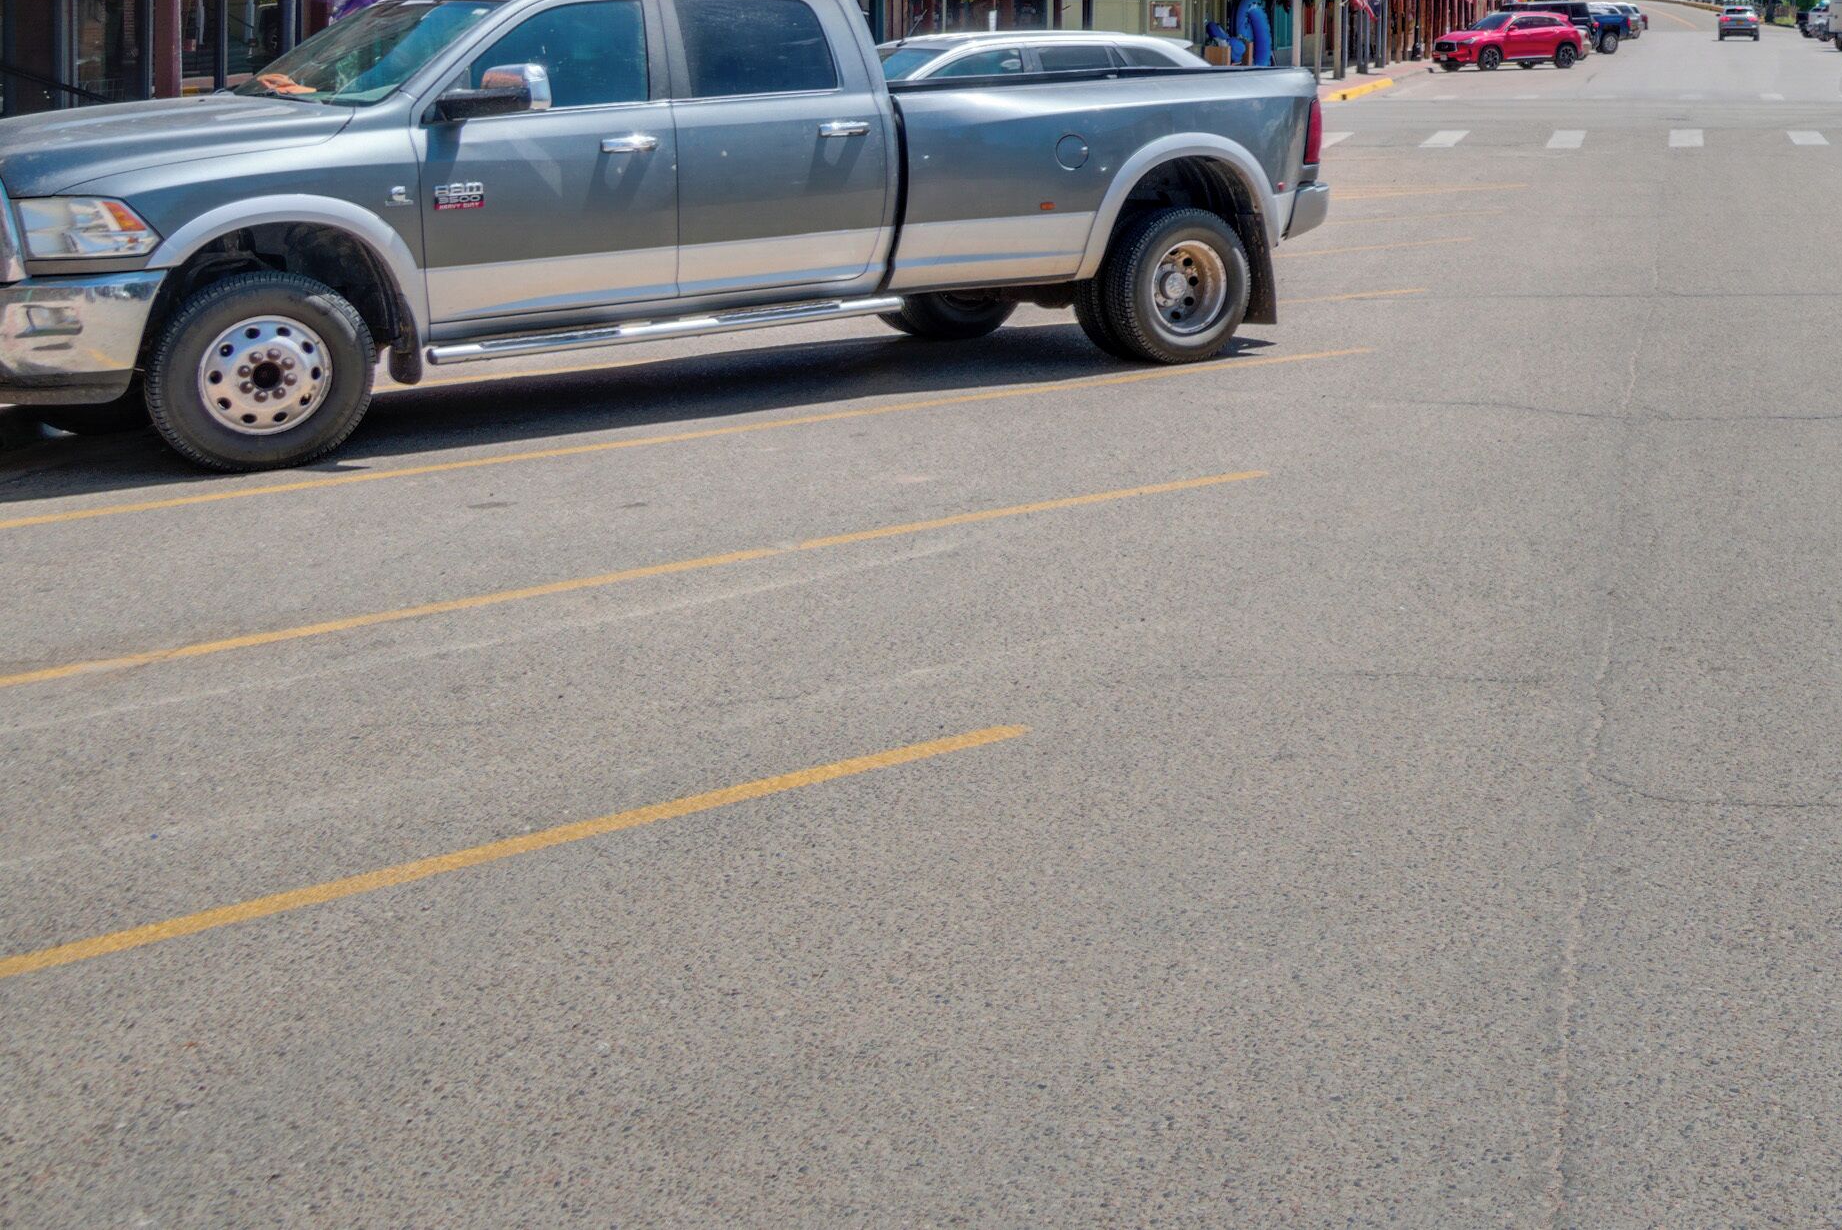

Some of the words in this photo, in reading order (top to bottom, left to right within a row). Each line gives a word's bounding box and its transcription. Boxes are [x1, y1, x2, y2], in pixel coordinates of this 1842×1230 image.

[434, 182, 484, 197] RAM
[439, 194, 481, 205] 3500
[439, 202, 462, 210] HEAVY
